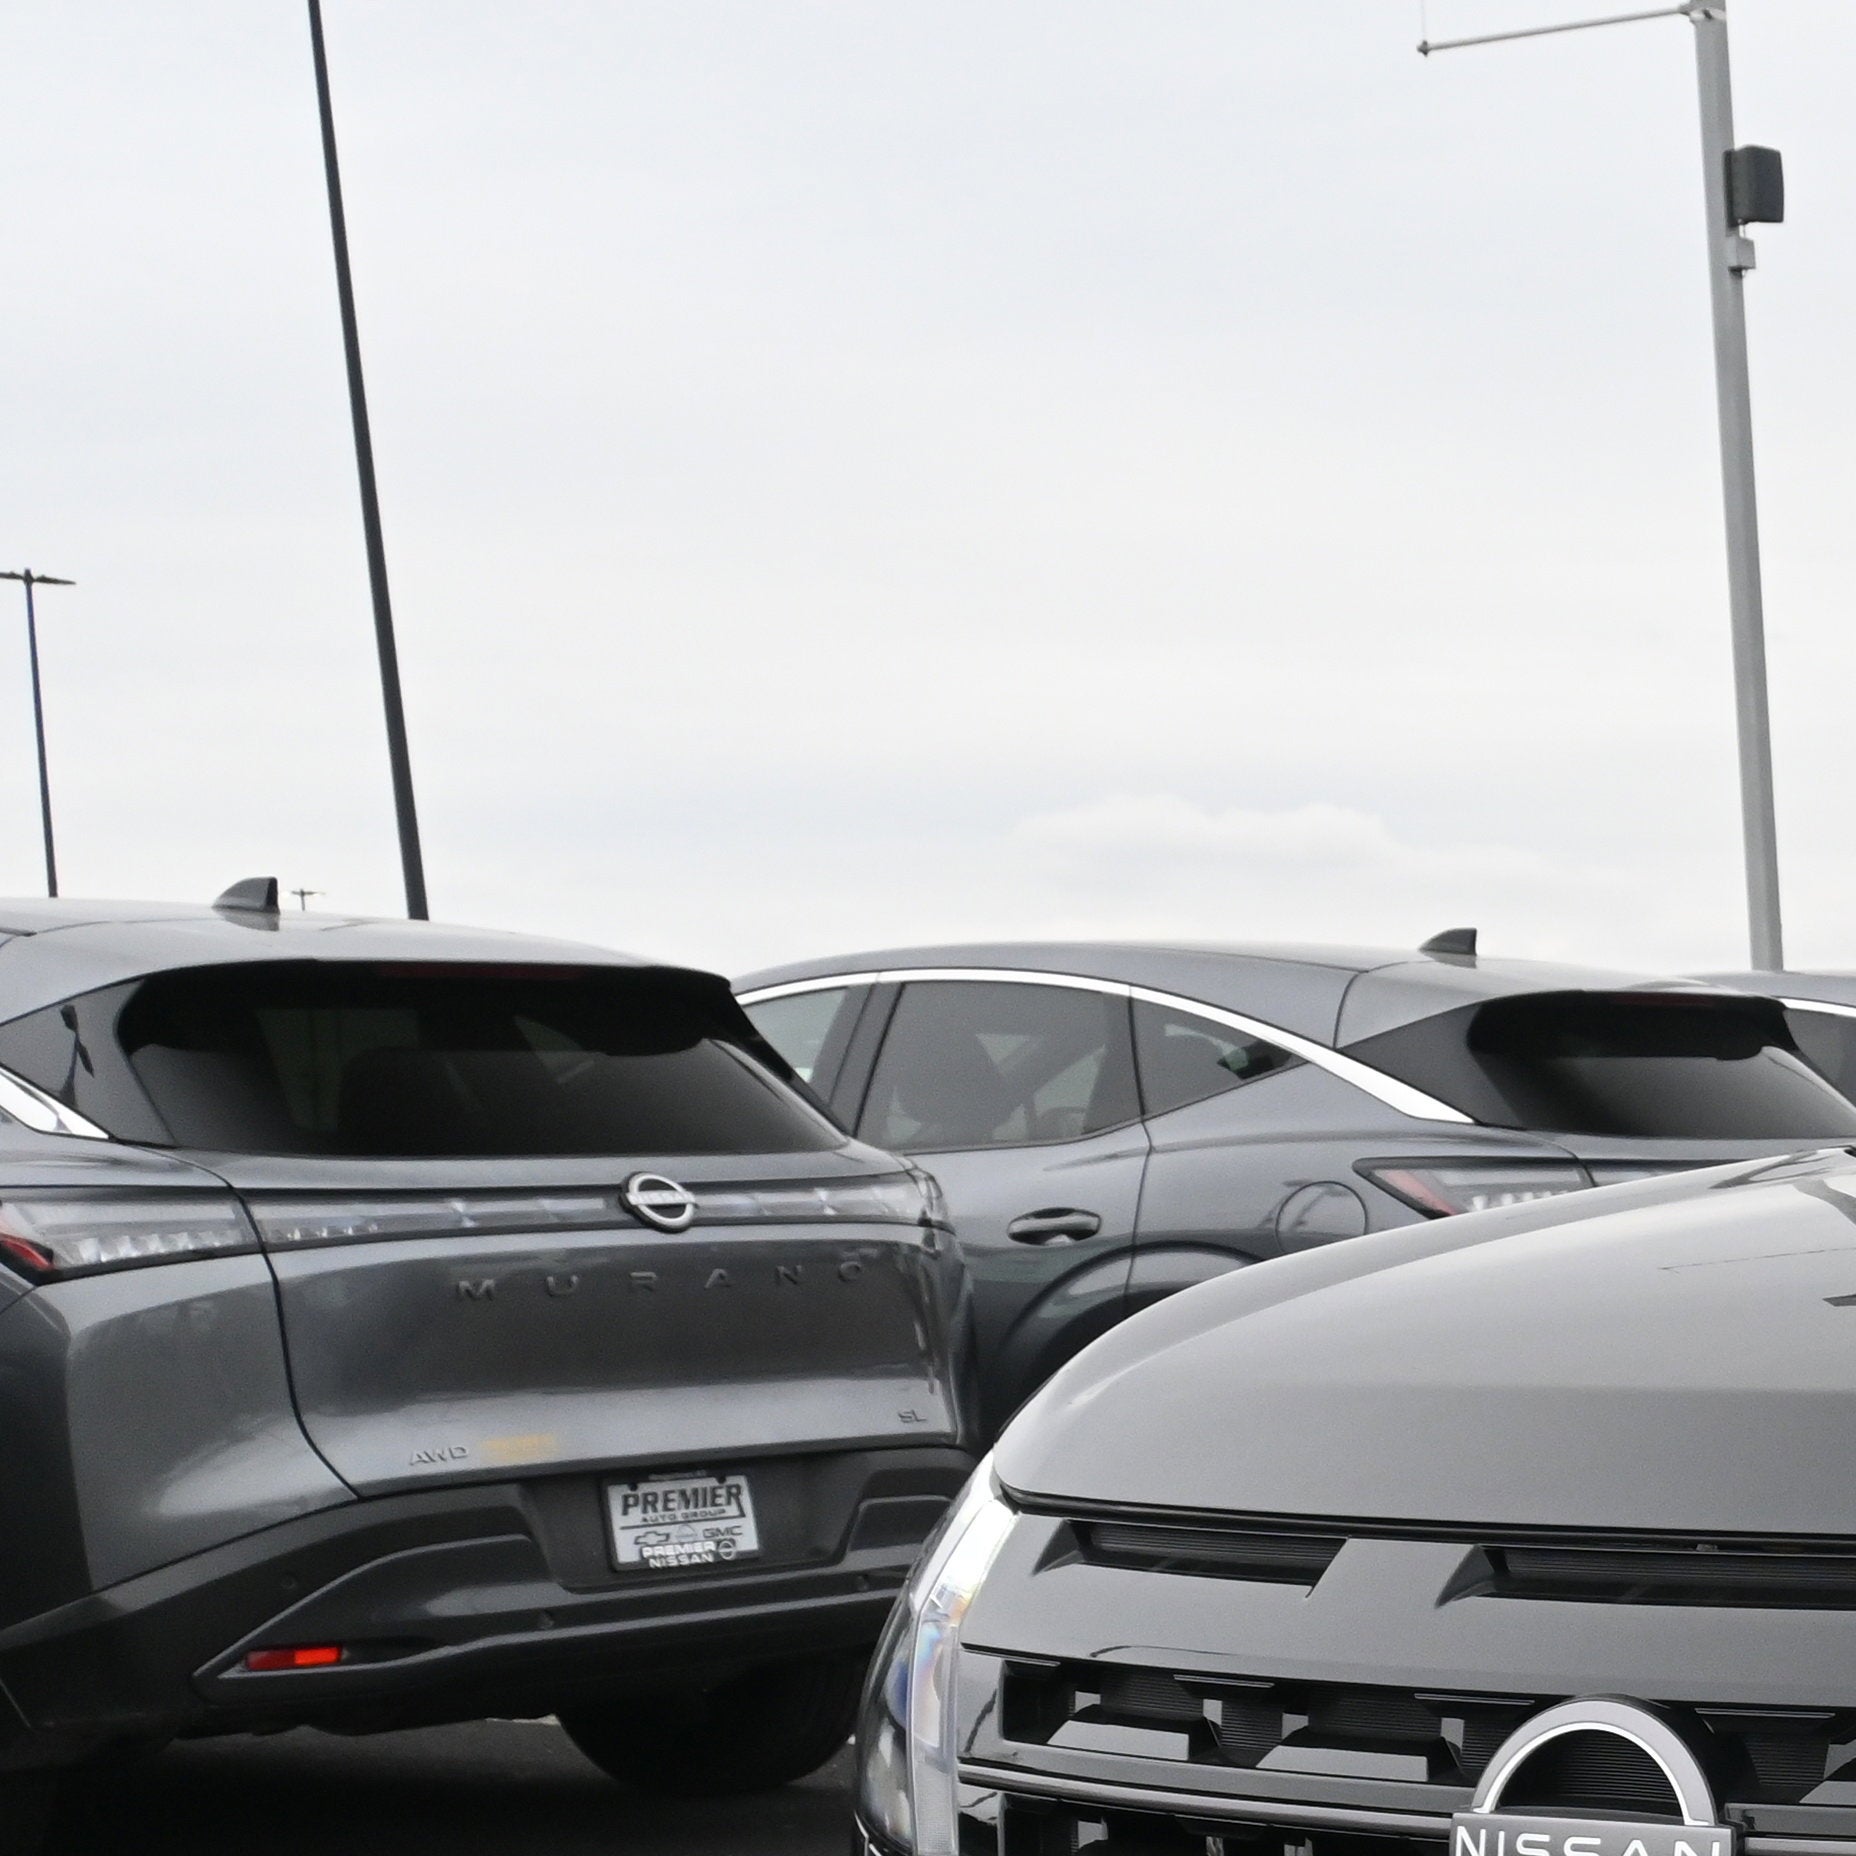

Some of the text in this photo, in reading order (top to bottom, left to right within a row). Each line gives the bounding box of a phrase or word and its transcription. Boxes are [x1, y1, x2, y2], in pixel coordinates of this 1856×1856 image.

[456, 1260, 863, 1302] MURANO
[409, 1445, 468, 1466] AWD
[621, 1483, 746, 1517] PREMIER
[640, 1508, 726, 1524] AUTO GROUP
[702, 1525, 743, 1539] GMC
[641, 1541, 716, 1558] PREMIER
[648, 1552, 715, 1569] NISSAN
